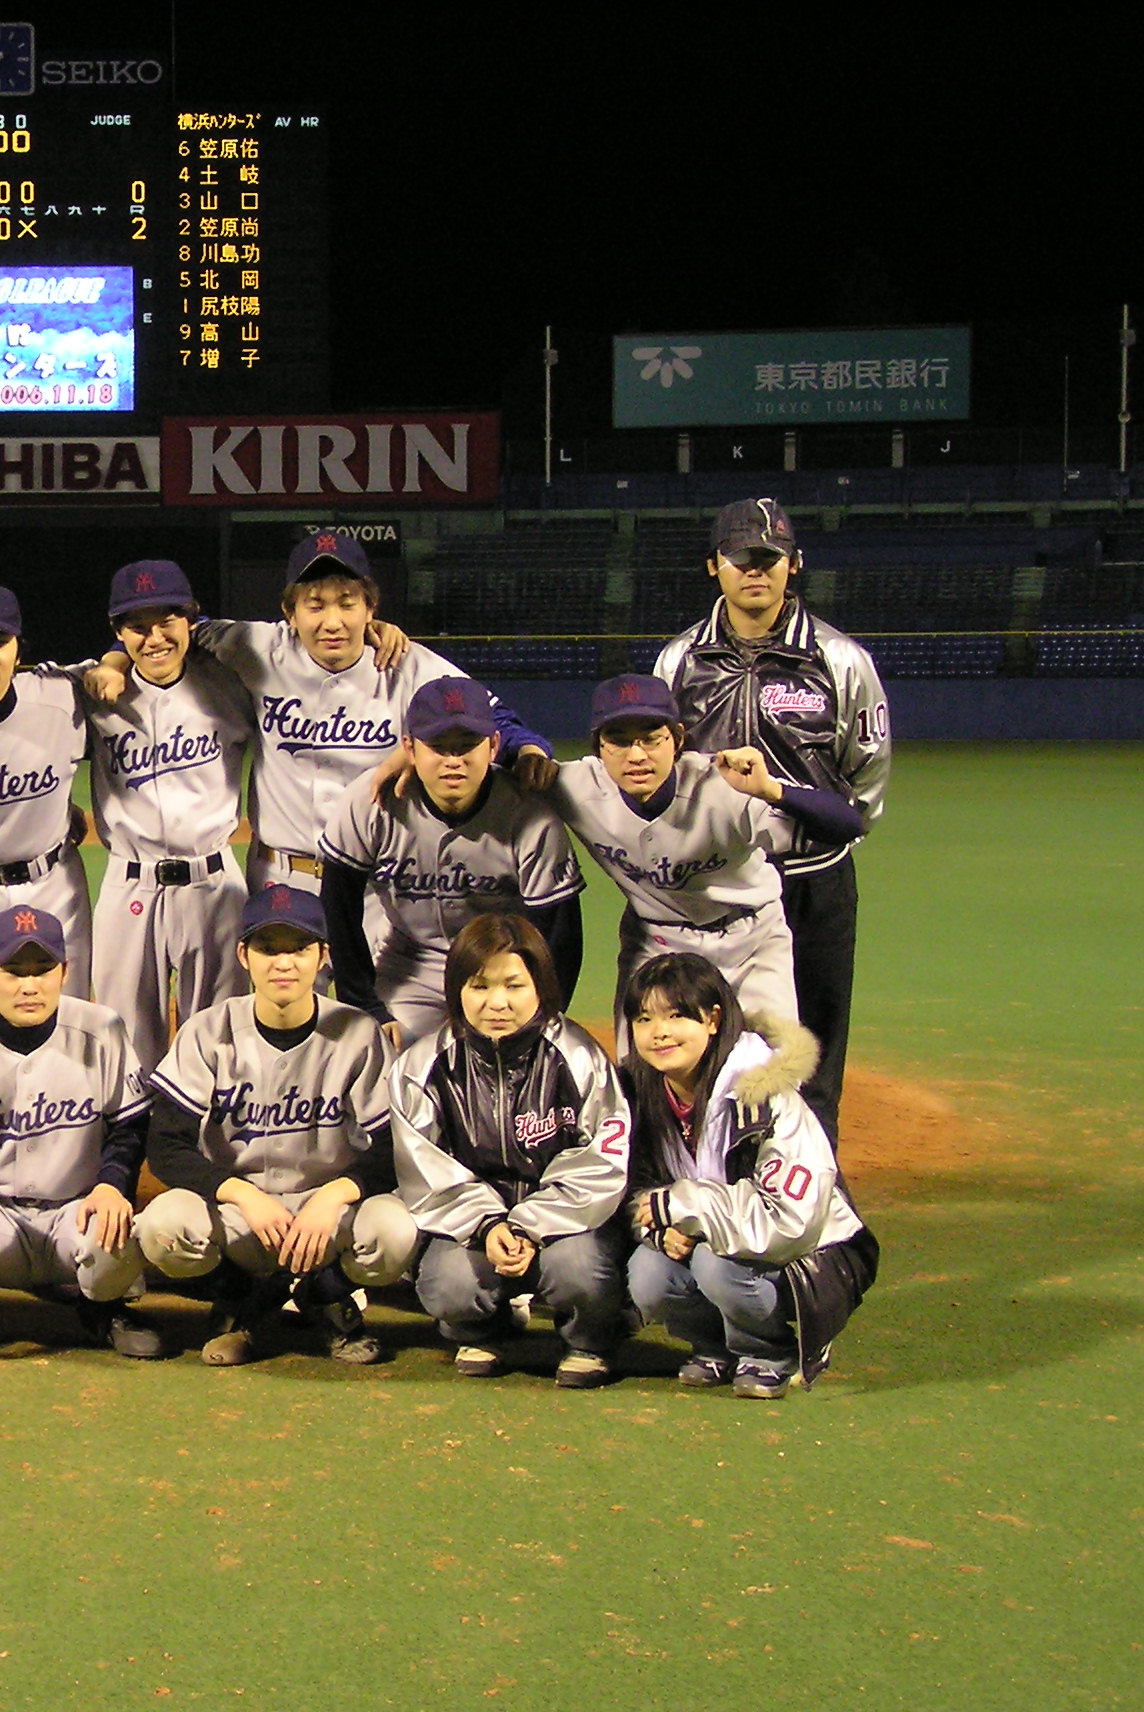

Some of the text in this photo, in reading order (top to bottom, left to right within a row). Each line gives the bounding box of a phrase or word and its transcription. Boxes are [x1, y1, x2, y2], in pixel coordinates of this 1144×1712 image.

[42, 60, 162, 84] SEIKO
[90, 114, 131, 126] JUDGE
[274, 116, 320, 127] AV HR
[178, 137, 259, 159] 6 笠原佑
[178, 166, 191, 183] 4
[131, 180, 146, 204] 0
[178, 192, 191, 209] 3
[131, 216, 147, 240] 2
[178, 216, 259, 238] 2 笠原尚
[178, 242, 261, 264] 8 川島功
[179, 271, 192, 288] 5
[182, 298, 189, 314] 1
[179, 323, 192, 340] 9
[179, 349, 192, 366] 7
[754, 357, 951, 393] 東京都民銀行
[898, 398, 948, 412] BANK
[732, 445, 744, 458] K
[940, 440, 952, 453] J
[189, 423, 470, 495] KIRIN
[325, 525, 397, 541] OYOTA
[760, 683, 826, 715] Hunters
[263, 695, 397, 755] Hunters
[857, 702, 887, 742] 10
[109, 725, 221, 791] Hunters
[212, 1082, 346, 1146] Hunters
[761, 1158, 813, 1201] 20
